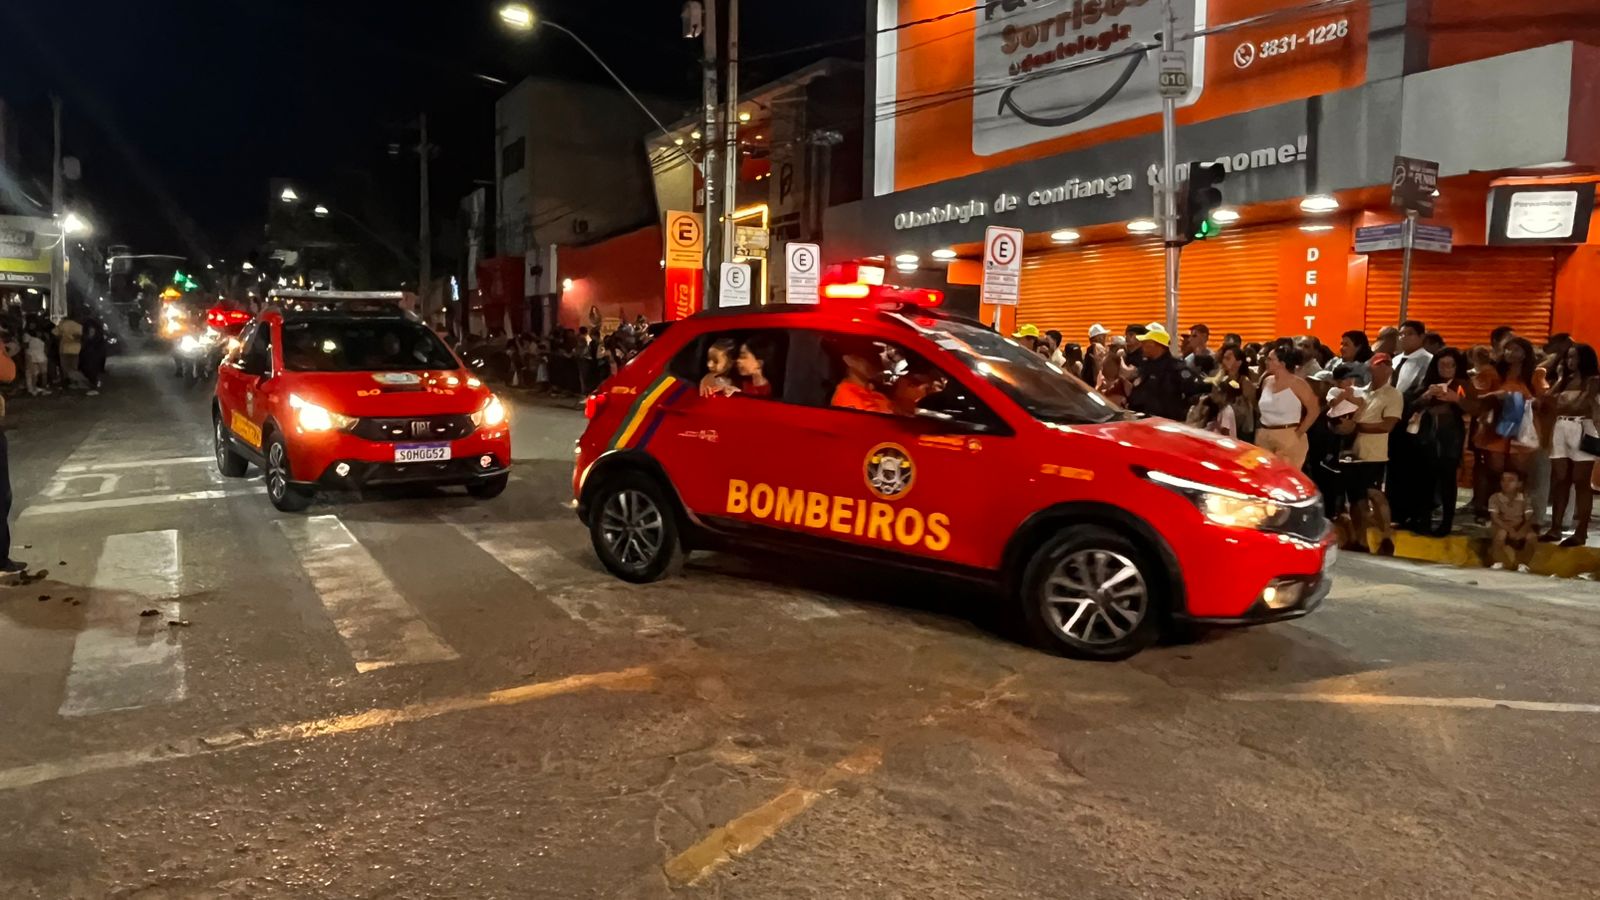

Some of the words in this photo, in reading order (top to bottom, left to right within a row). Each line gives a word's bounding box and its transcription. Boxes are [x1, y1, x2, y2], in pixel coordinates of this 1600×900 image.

[1001, 0, 1149, 55] Sorriso
[1259, 19, 1349, 60] 3831-1228
[994, 193, 1017, 213] de
[1027, 172, 1133, 198] confiança
[678, 222, 693, 241] E
[1000, 241, 1008, 258] E
[799, 253, 807, 267] E
[732, 271, 739, 284] E
[411, 421, 431, 434] FIAT
[727, 478, 951, 552] BOMBEIROS
